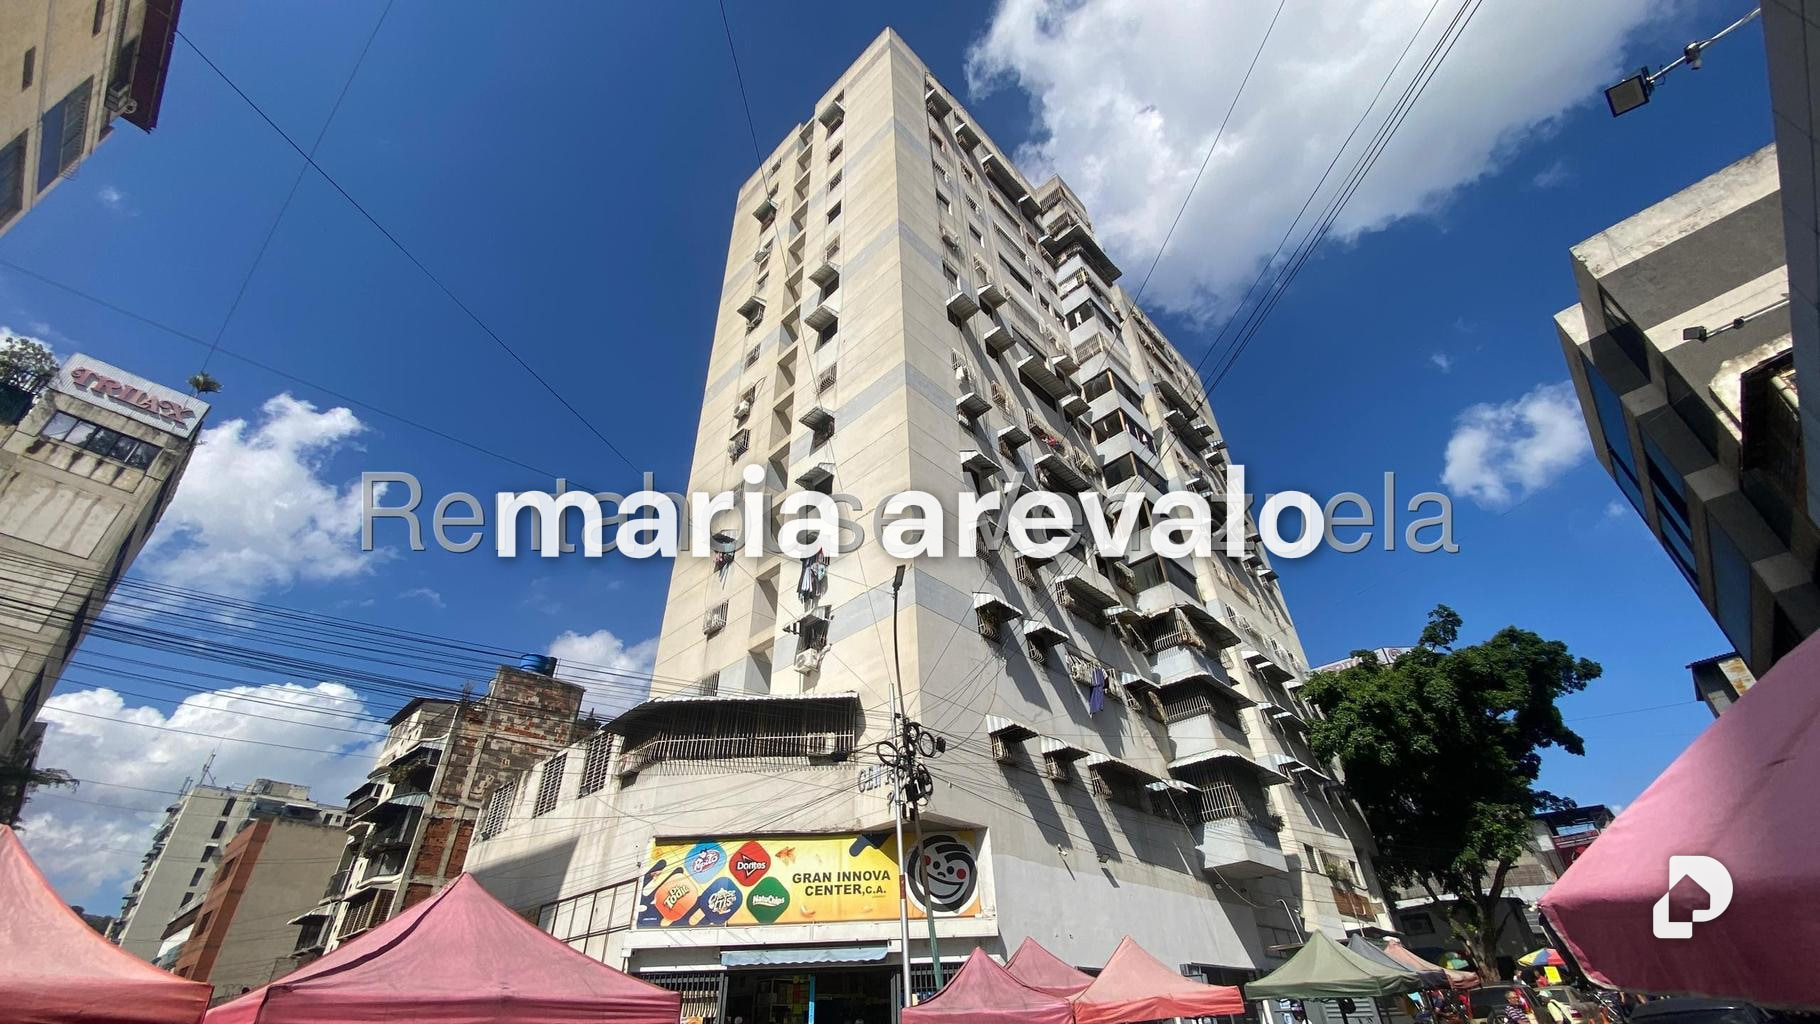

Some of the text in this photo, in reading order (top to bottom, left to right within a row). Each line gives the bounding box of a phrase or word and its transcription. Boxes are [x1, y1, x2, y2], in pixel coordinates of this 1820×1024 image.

[737, 860, 766, 871] Doritos
[792, 870, 891, 884] GRAN INNOVA
